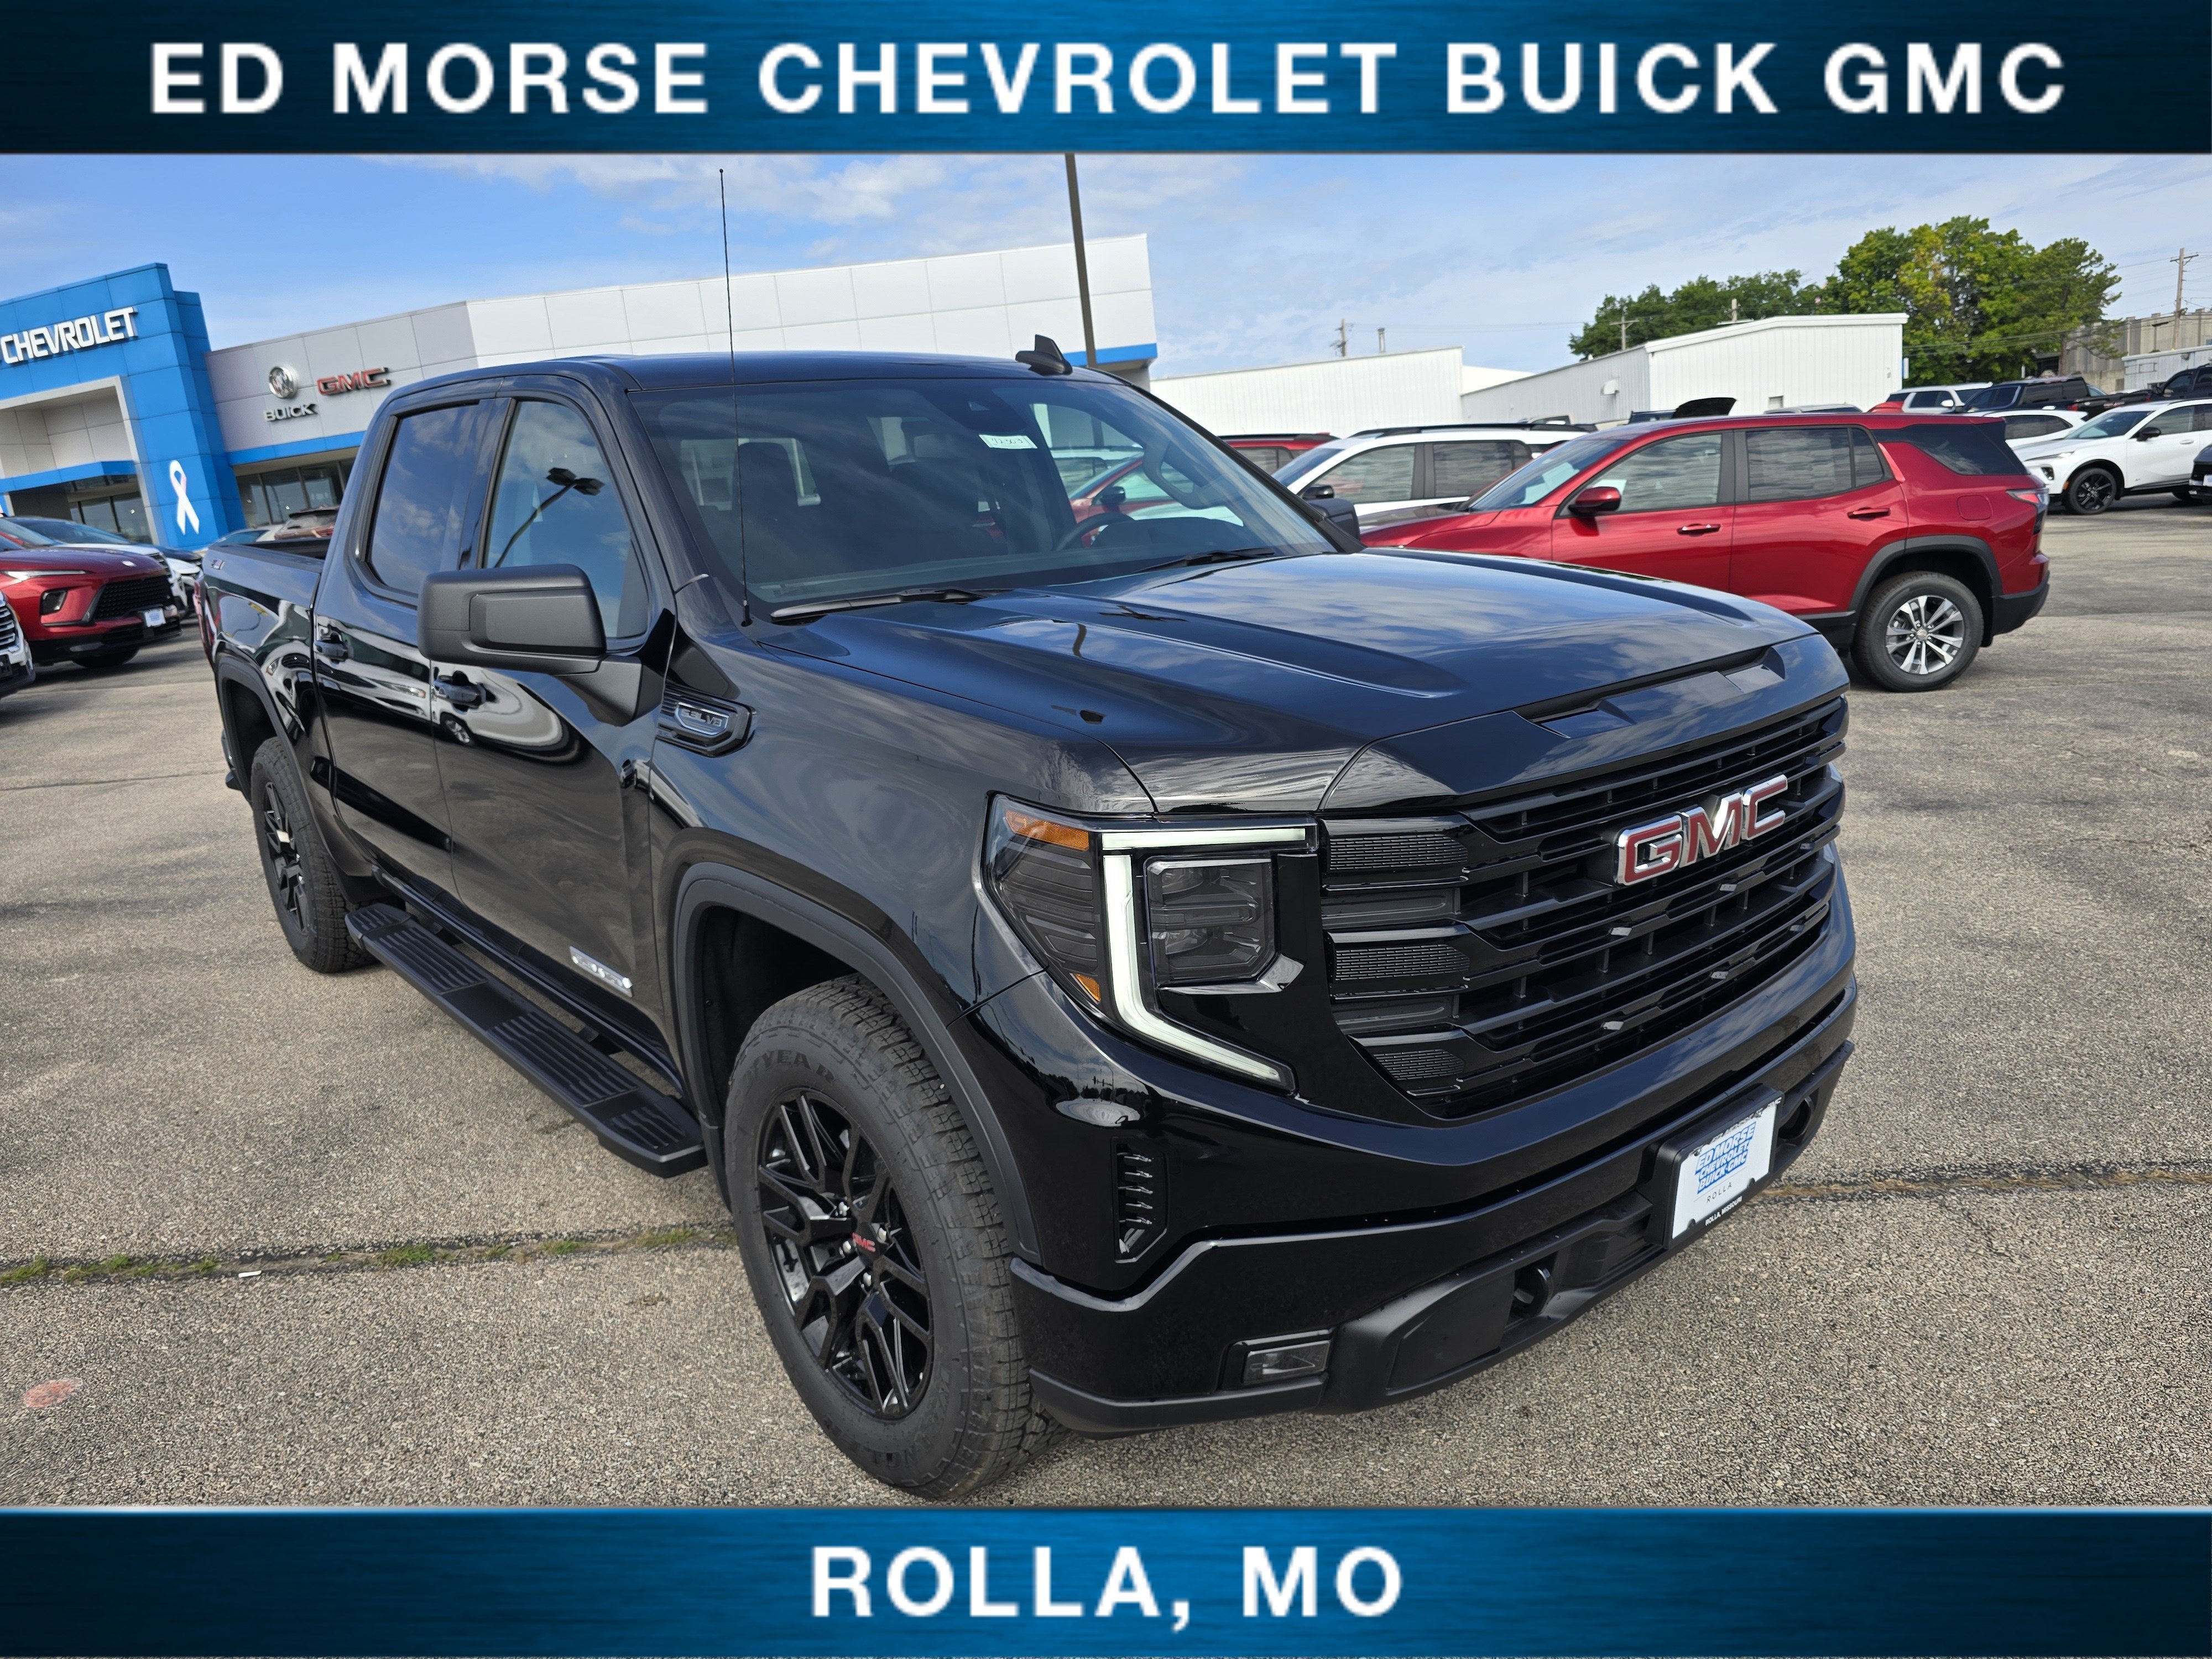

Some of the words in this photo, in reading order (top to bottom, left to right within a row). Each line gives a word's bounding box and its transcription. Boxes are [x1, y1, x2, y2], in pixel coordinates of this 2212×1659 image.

[1, 307, 134, 364] CHEVROLET
[316, 367, 389, 395] GMC
[264, 403, 316, 422] BUICK
[1615, 774, 1787, 886] GMC
[1697, 1148, 1714, 1172] ED
[1714, 1122, 1756, 1159] MORSE
[1699, 1140, 1750, 1180] CHEVROLET
[1707, 1182, 1732, 1203] ROLLA
